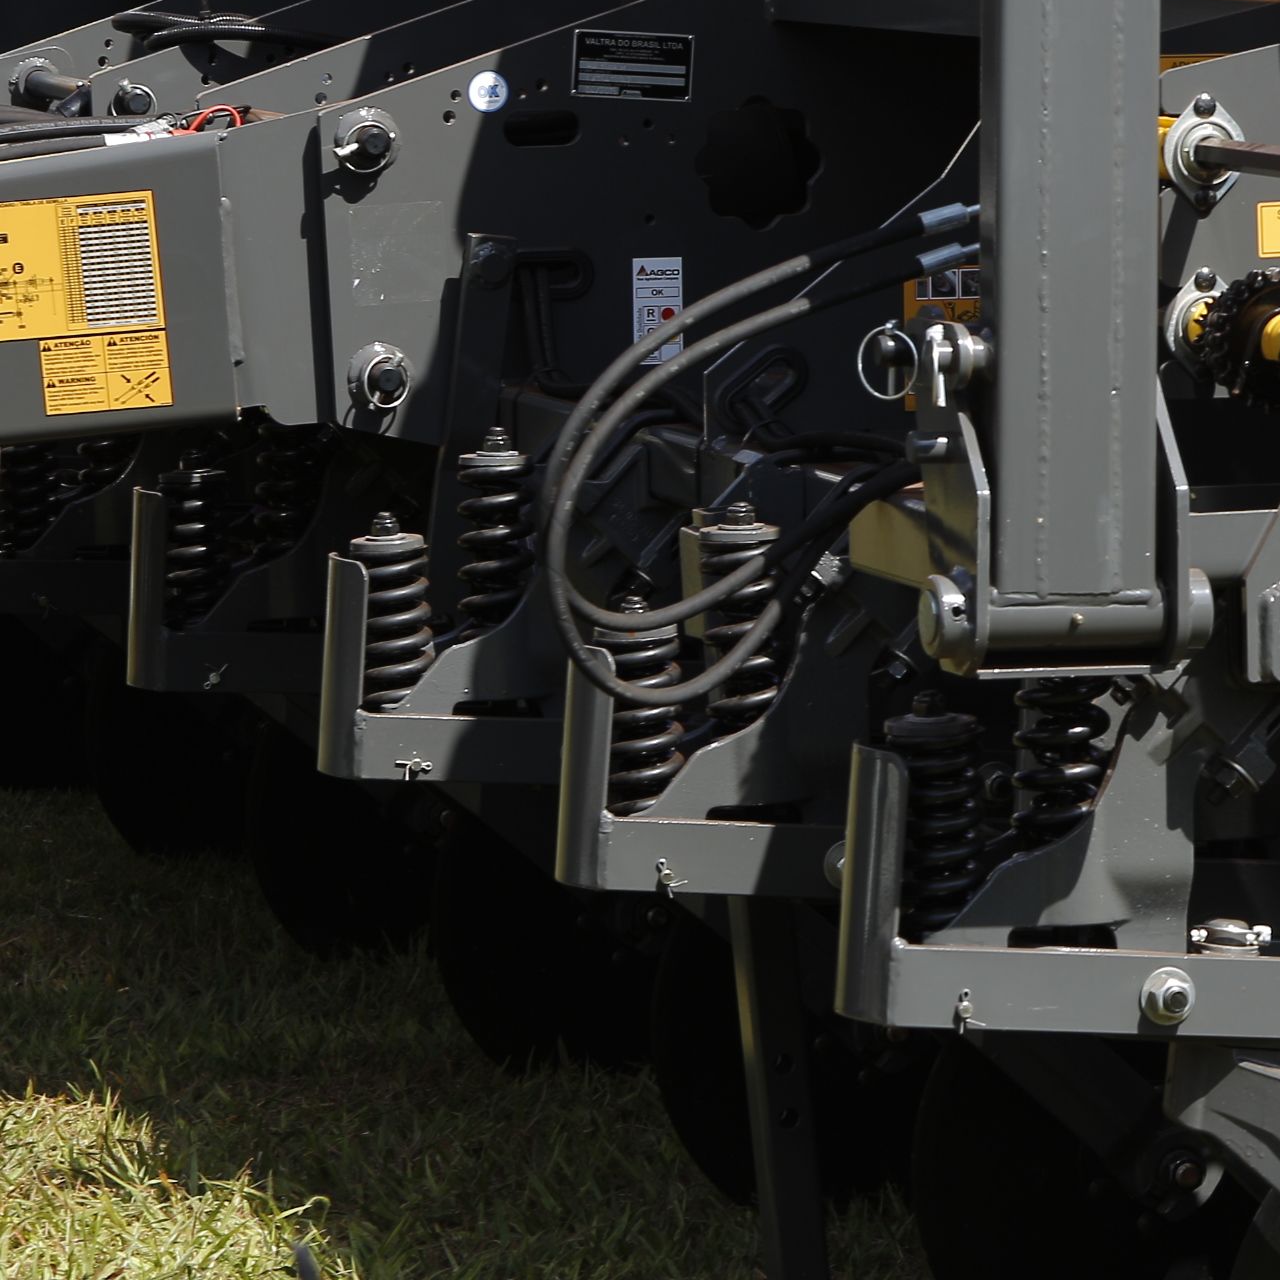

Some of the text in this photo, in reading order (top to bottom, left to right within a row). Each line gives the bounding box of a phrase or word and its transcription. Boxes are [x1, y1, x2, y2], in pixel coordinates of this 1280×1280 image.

[585, 37, 684, 50] VALTRA DO BRASIL LTDA
[646, 308, 655, 318] R
[54, 339, 91, 348] ATENÇÃO
[58, 376, 96, 385] WARNING
